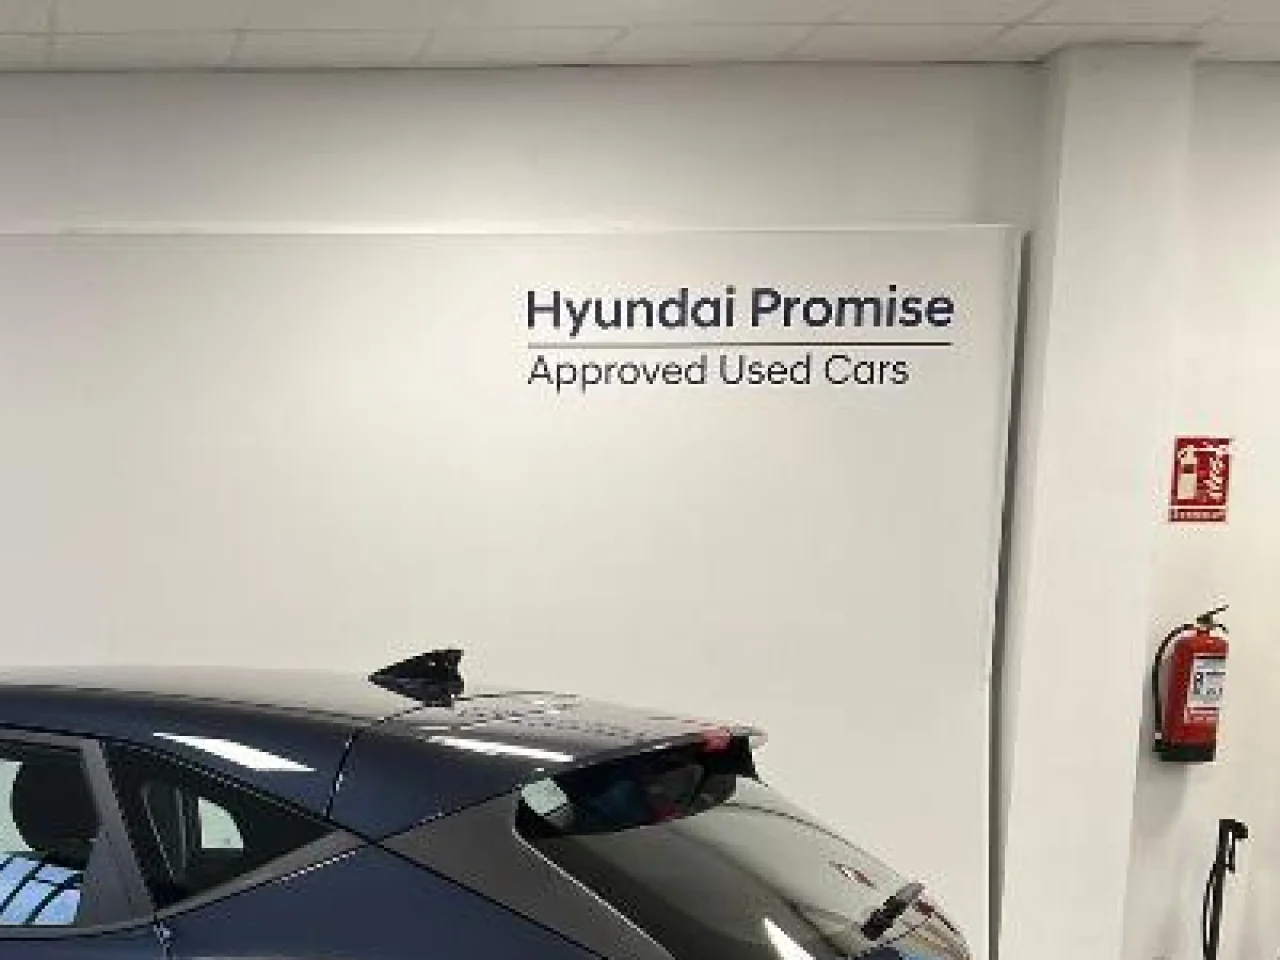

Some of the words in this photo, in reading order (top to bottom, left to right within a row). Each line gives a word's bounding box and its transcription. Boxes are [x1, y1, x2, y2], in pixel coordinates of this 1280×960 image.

[527, 285, 735, 338] Hyundai
[751, 284, 955, 327] Promise
[527, 354, 708, 394] Approved
[720, 353, 812, 385] Used
[824, 354, 910, 385] Cars
